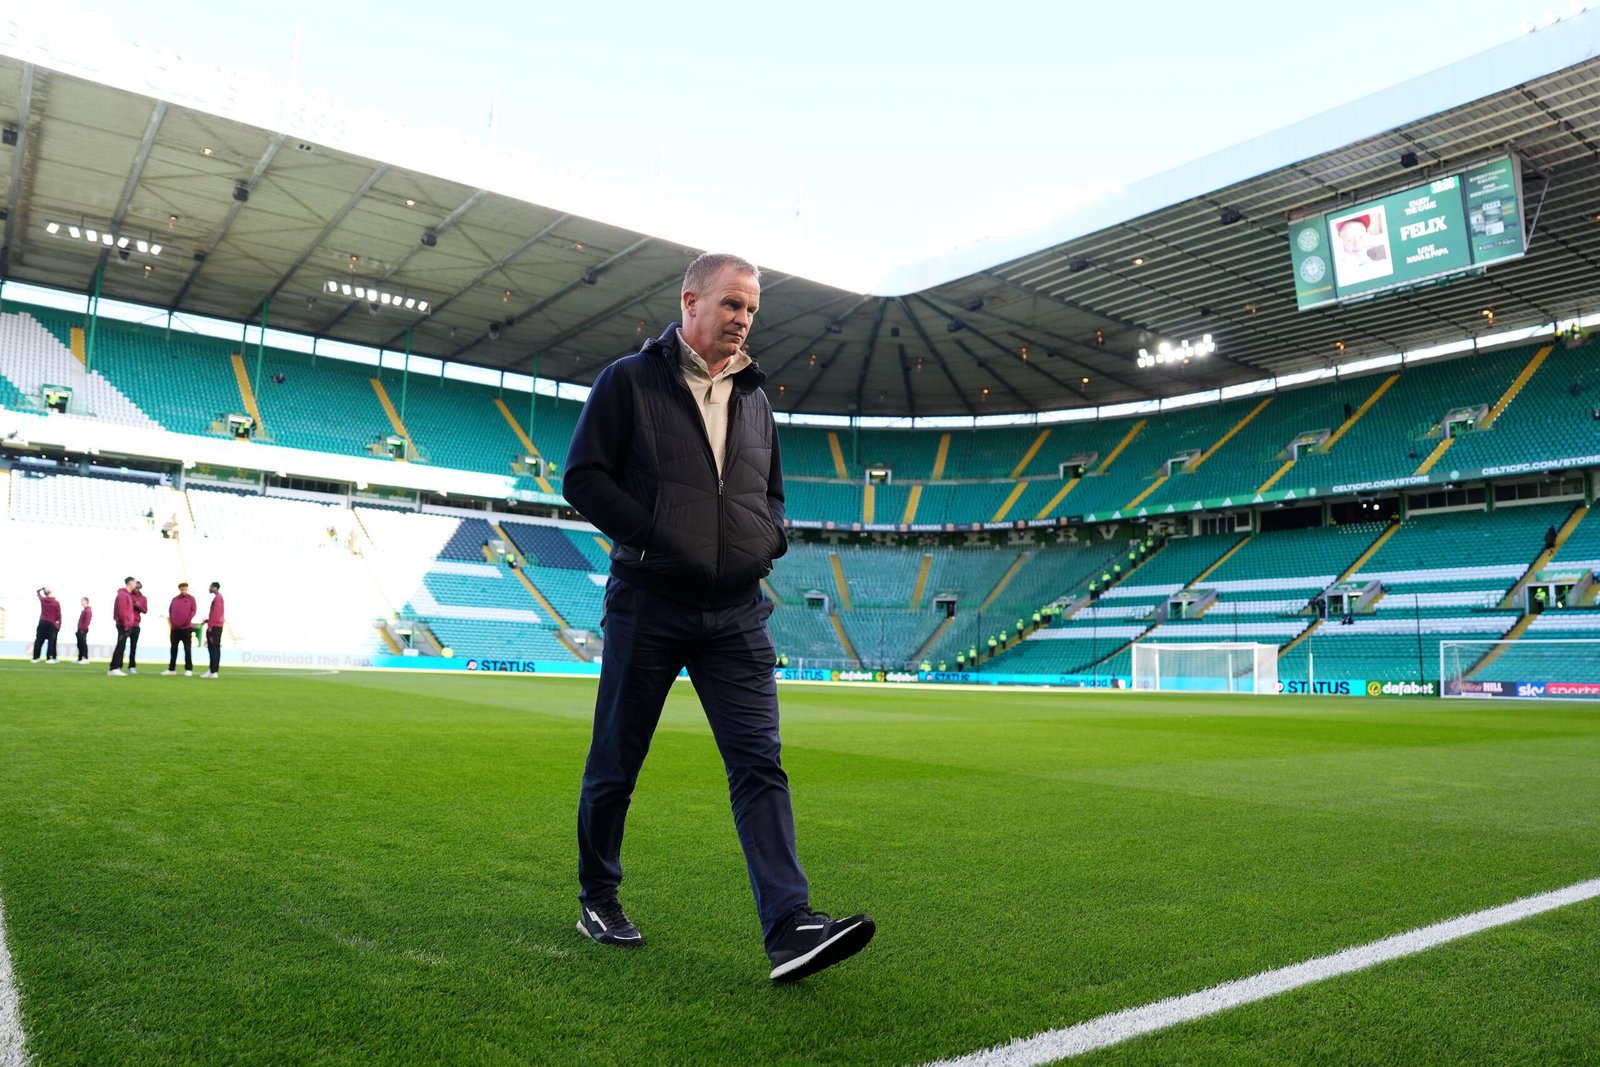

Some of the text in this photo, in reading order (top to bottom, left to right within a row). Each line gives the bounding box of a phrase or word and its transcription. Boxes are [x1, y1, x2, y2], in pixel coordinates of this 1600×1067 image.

[1400, 215, 1448, 241] FELIX
[1482, 455, 1600, 475] CELTICFC.COM/STORE
[1332, 475, 1430, 493] CELTICFC.COM/STORE
[242, 651, 373, 667] Download the App.
[481, 660, 535, 673] STATUS
[839, 670, 873, 682] dafabet
[886, 672, 918, 683] dafabet
[1382, 681, 1434, 696] dafabet
[1483, 682, 1503, 692] HILL
[1518, 684, 1545, 697] sky
